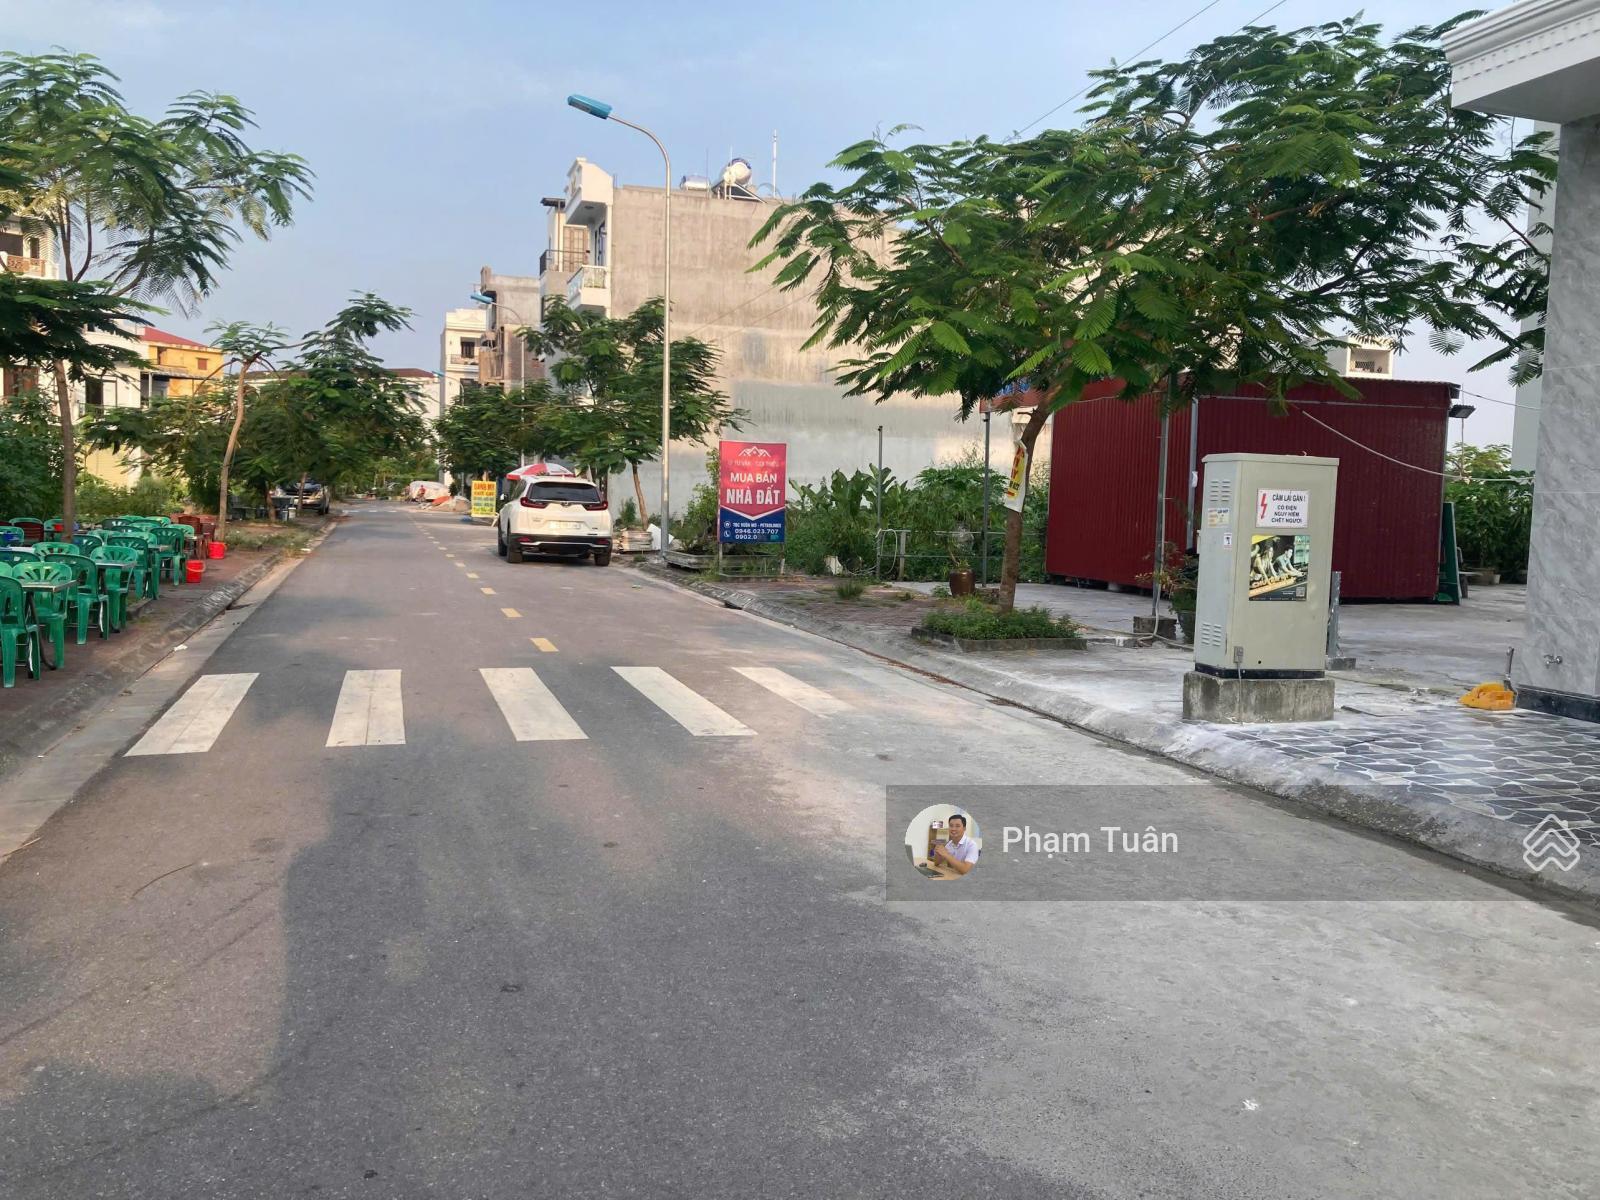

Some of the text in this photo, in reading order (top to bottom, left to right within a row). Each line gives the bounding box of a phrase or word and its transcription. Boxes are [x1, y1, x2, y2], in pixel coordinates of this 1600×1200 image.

[730, 470, 777, 483] MUA BÁN
[726, 484, 780, 505] NHÀ ĐẤT
